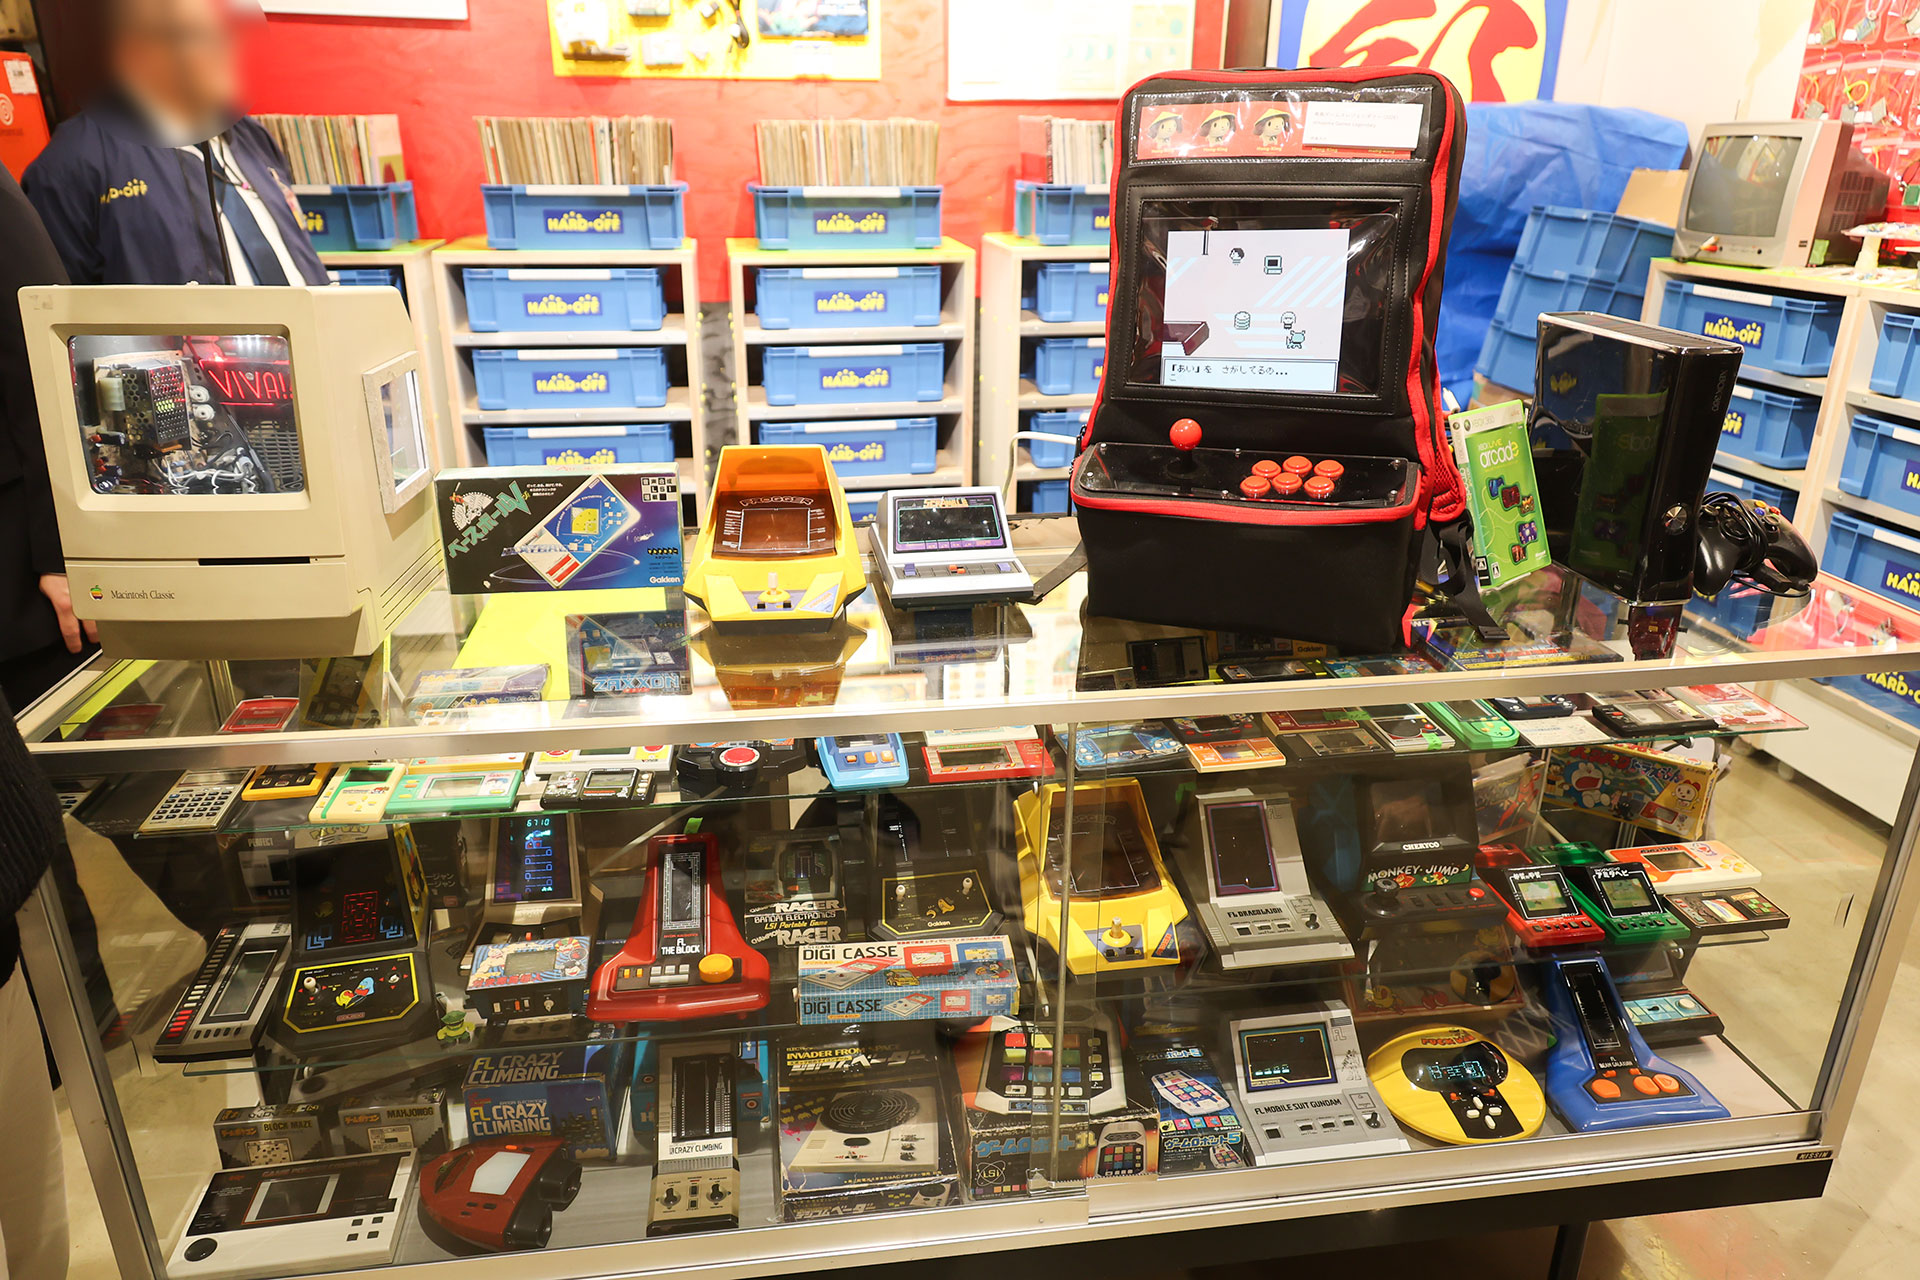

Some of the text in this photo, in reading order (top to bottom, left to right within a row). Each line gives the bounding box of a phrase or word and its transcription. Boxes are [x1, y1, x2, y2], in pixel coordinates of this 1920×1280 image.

[1479, 441, 1519, 469] arcade
[649, 576, 681, 585] Gakken
[110, 589, 175, 600] Macintosh Classic
[593, 670, 680, 692] ZAXXON
[247, 837, 275, 848] PERFECT
[1425, 865, 1460, 876] JUMP
[775, 900, 840, 913] RACER
[754, 911, 836, 924] BANDAI ELECTRONICS
[927, 920, 951, 928] Gakken
[764, 919, 828, 930] LSI Portable Game
[676, 937, 687, 947] FL
[777, 926, 842, 946] RACER
[661, 944, 701, 955] THE BLOCK
[803, 946, 898, 960] DIGI CASSE
[803, 999, 882, 1015] DIGI CASSE
[786, 1049, 833, 1060] INVADER
[835, 1047, 866, 1056] FROM
[473, 1051, 564, 1071] FL CRAZY
[468, 1065, 560, 1084] CLIMBING
[469, 1102, 547, 1122] FL CRAZY
[1255, 1098, 1342, 1115] FL MOBILE SUIT GUNDAM
[263, 1120, 313, 1132] BLOCK MAZE
[472, 1117, 550, 1136] CLIMBING
[1164, 1131, 1241, 1149] ゲームロボット5
[674, 1145, 695, 1155] CRAZY
[695, 1142, 723, 1153] CLIMBING
[1799, 1151, 1829, 1160] NISSIN
[983, 1168, 1001, 1179] LSI
